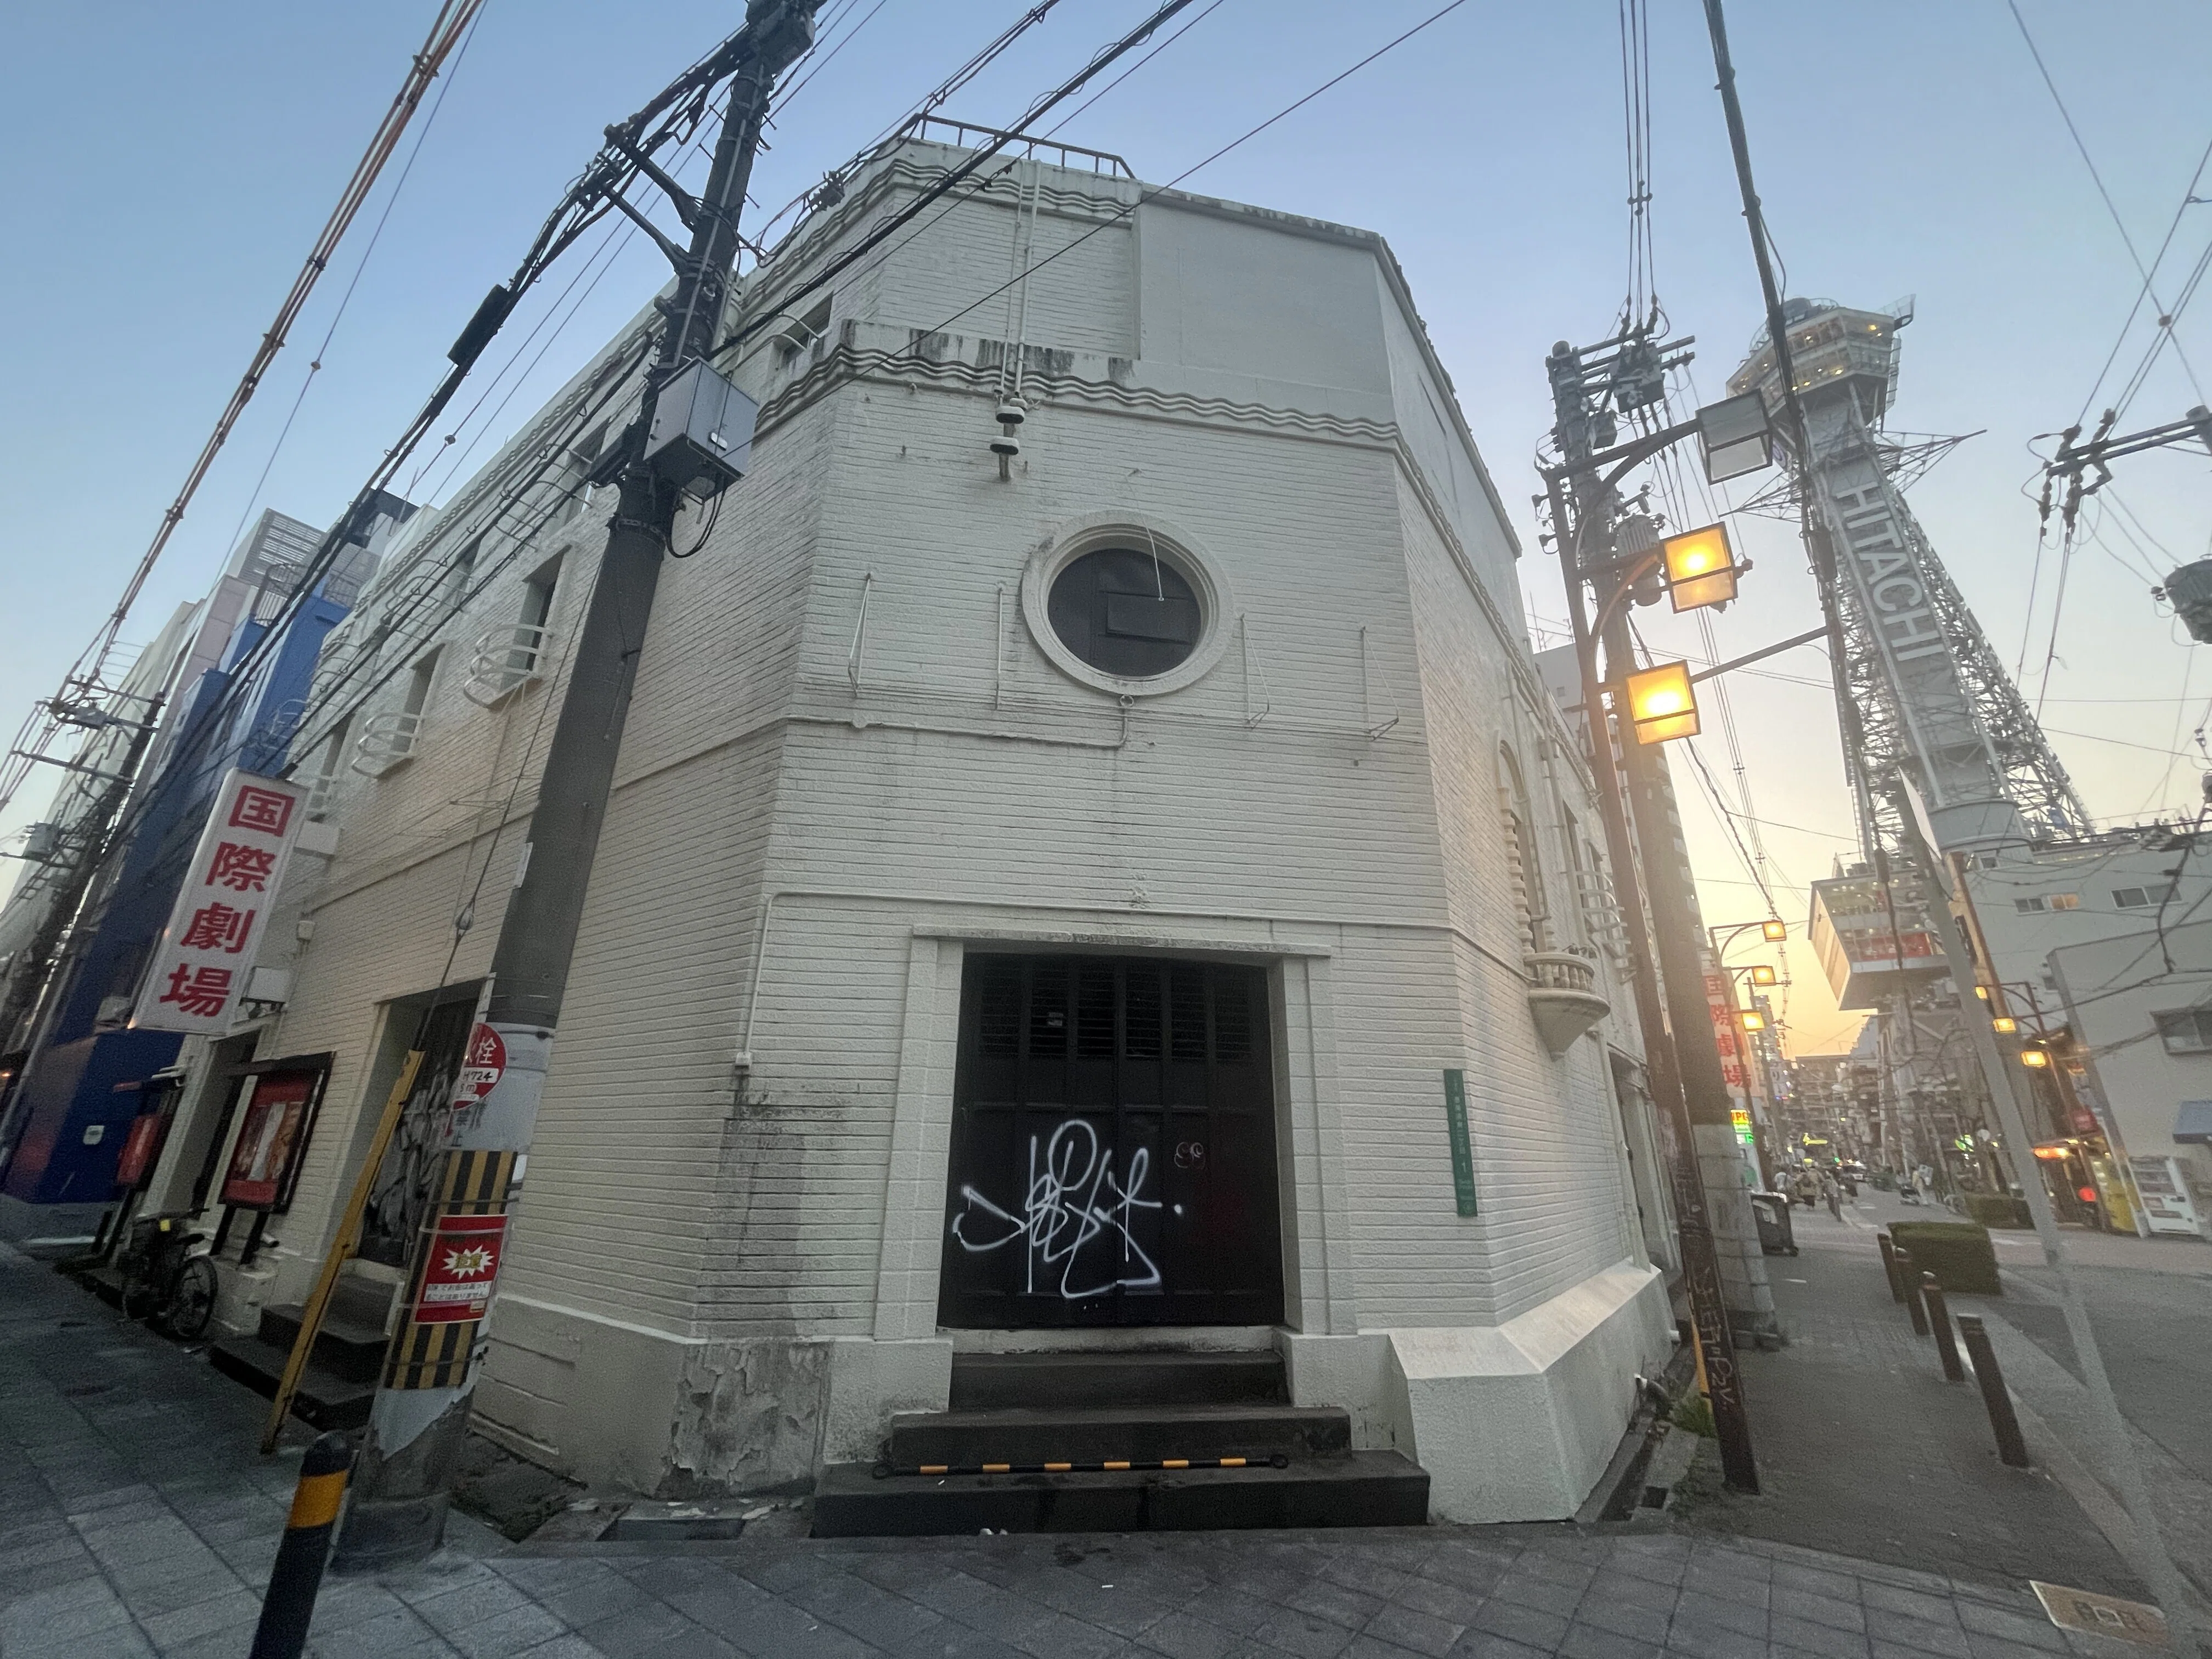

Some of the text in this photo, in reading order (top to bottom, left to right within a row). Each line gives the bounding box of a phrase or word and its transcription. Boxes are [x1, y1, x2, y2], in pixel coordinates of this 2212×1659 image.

[1837, 481, 1946, 661] HITACHI
[160, 785, 295, 1017] 国際劇場
